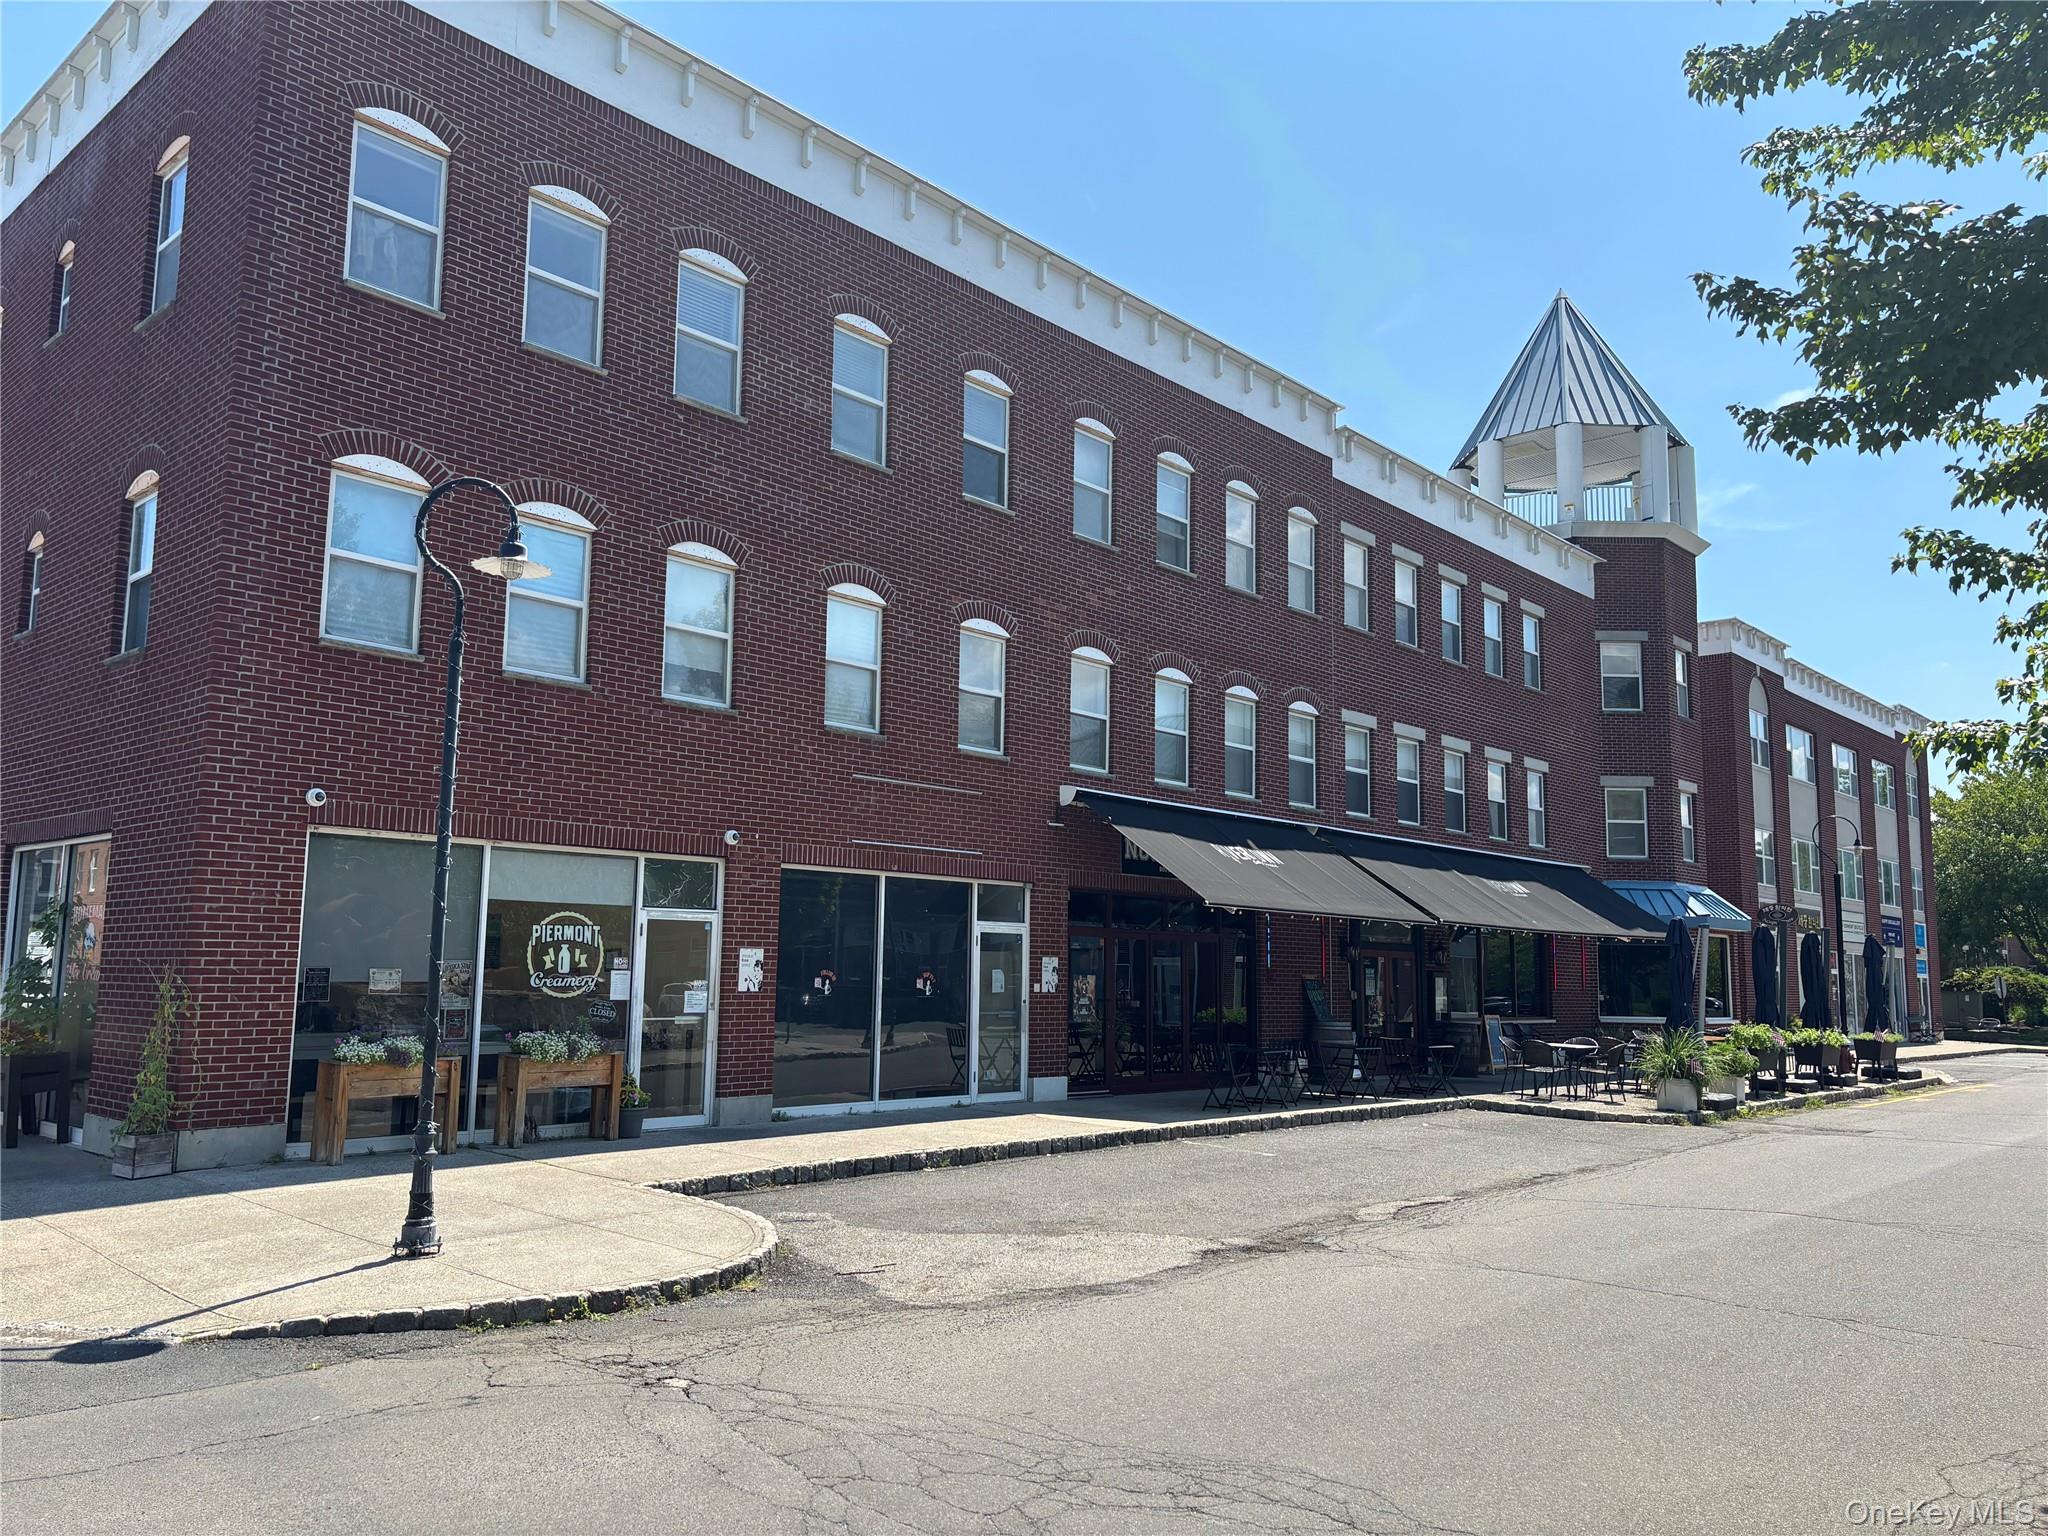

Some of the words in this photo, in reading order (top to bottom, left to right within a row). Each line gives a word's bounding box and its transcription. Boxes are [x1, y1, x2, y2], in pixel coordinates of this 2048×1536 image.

[531, 924, 600, 948] PIERMONT
[530, 971, 598, 993] Creamery
[589, 1007, 616, 1017] CLOSED
